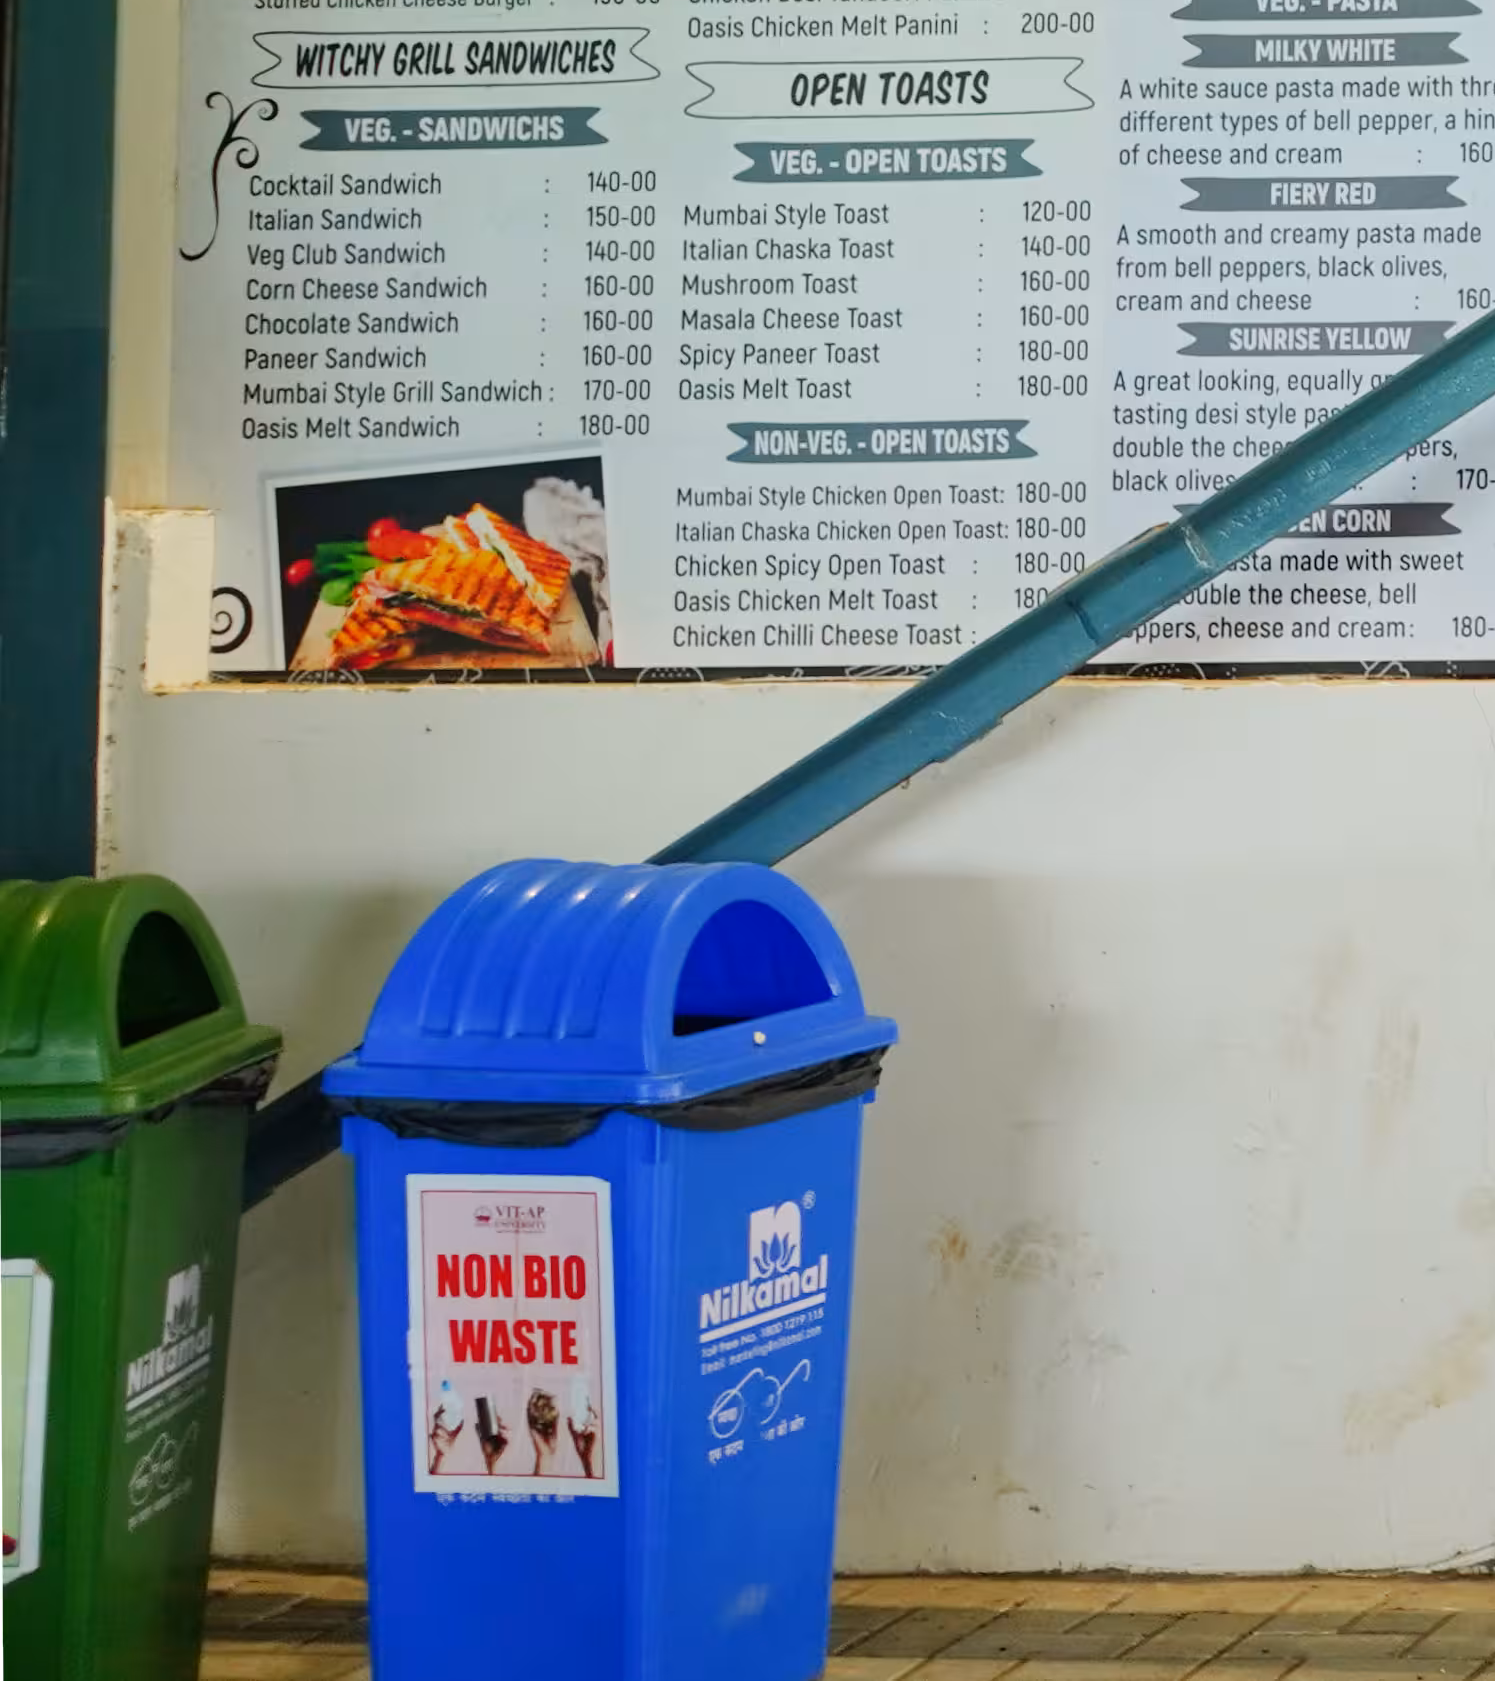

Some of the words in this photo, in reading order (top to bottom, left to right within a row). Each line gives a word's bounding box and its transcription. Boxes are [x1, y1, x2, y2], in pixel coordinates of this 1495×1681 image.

[296, 42, 386, 78] WITCHY
[393, 41, 455, 77] GRILL
[464, 38, 616, 76] SANDWICHES
[1255, 38, 1322, 62] MILKY
[1326, 38, 1396, 62] WHITE
[790, 72, 867, 107] OPEN
[879, 69, 990, 106] TOASTS
[1119, 78, 1133, 100] A
[1139, 76, 1198, 100] white
[1205, 81, 1268, 99] sauce
[1275, 78, 1334, 103] pasta
[1342, 75, 1401, 98] made
[1407, 75, 1453, 97] with
[770, 149, 823, 175] VEG.
[845, 148, 910, 174] OPEN
[916, 146, 1007, 173] TOASTS
[249, 173, 334, 197] Cocktail
[340, 172, 442, 196] Sandwich
[587, 170, 656, 193] 140-00
[1270, 182, 1330, 206] FIERY
[1334, 181, 1377, 205] RED
[1229, 327, 1321, 351] SUNRISE
[1325, 326, 1412, 351] YELLOW
[678, 378, 735, 401] Oasis
[743, 377, 789, 400] Melt
[795, 377, 852, 399] Toast
[1018, 374, 1088, 397] 180-00
[495, 1205, 546, 1219] VIT-AP
[437, 1254, 513, 1298] NON
[524, 1255, 586, 1300] BIO
[700, 1254, 828, 1329] Nilkamal
[449, 1319, 579, 1365] WASTE
[127, 1315, 213, 1396] Nilkamal
